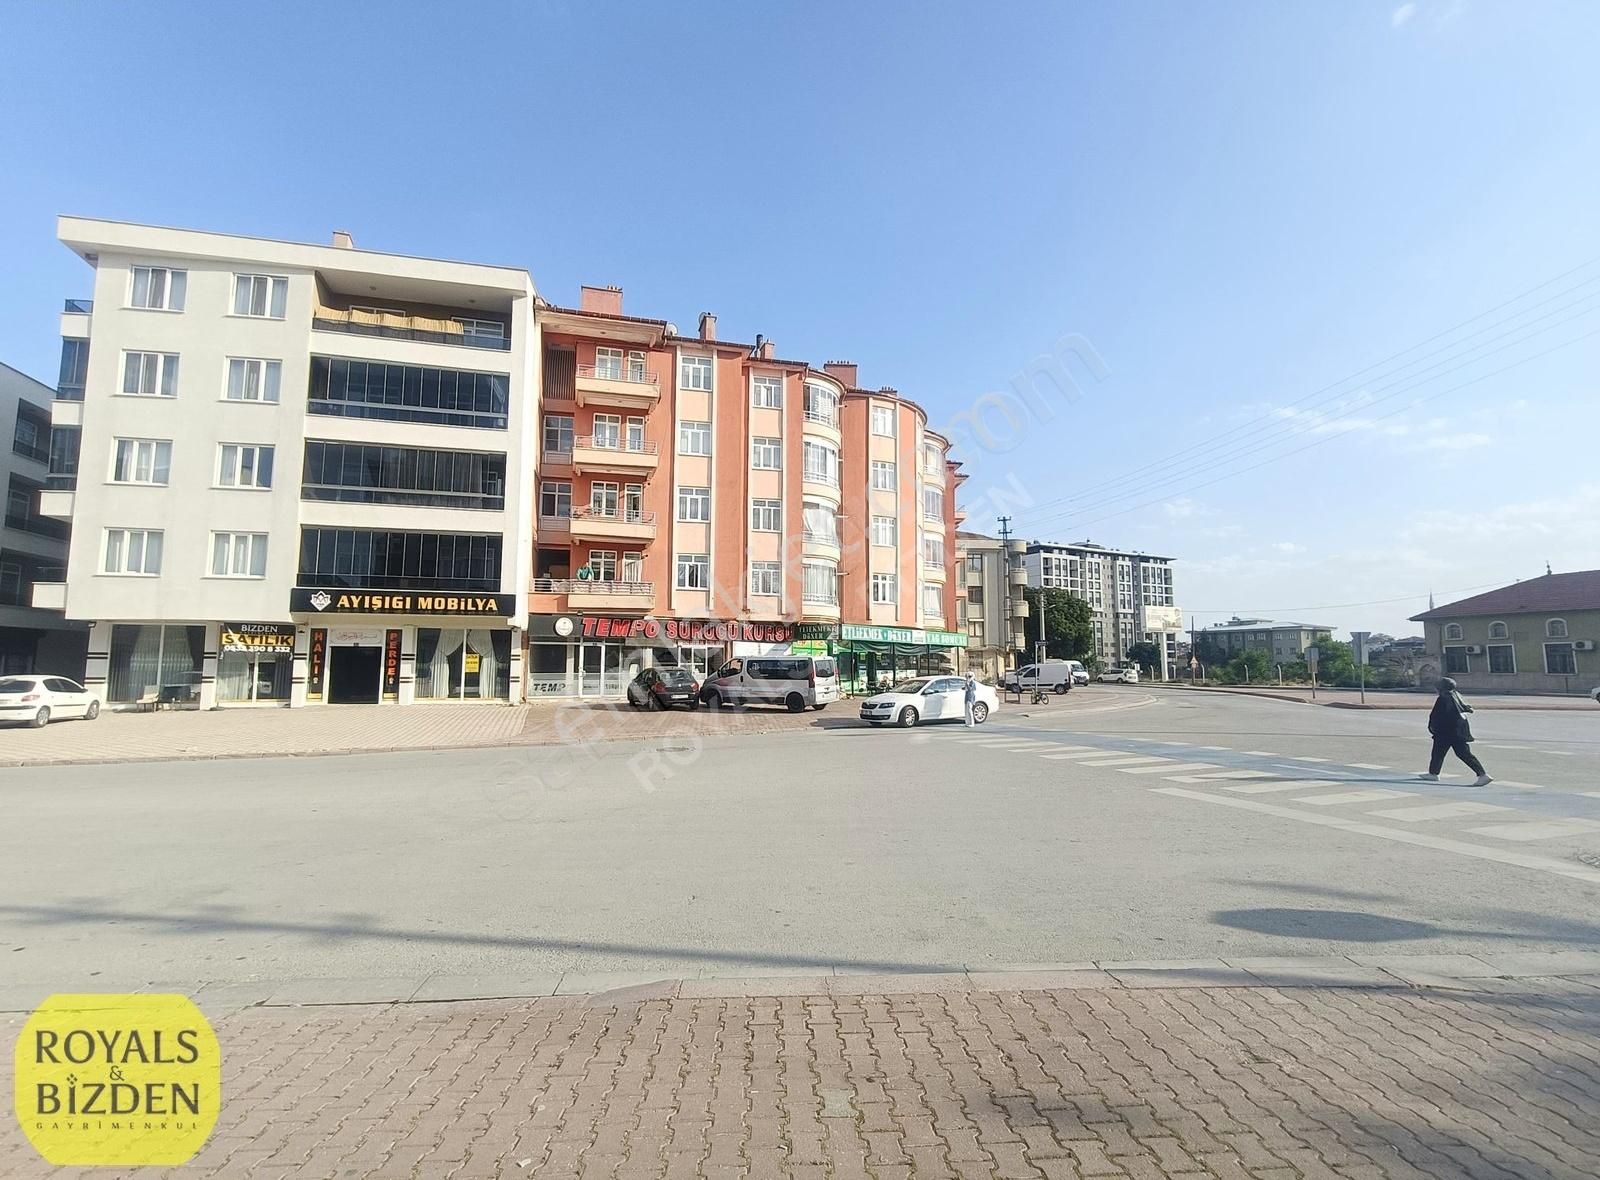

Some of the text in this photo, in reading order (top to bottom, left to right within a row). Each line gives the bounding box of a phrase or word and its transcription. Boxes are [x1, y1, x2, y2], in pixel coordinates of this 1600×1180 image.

[224, 634, 291, 645] SATILIK
[581, 616, 661, 638] TEMPO
[743, 621, 794, 641] KURSU
[313, 632, 323, 674] HALI
[387, 631, 398, 675] PERDE
